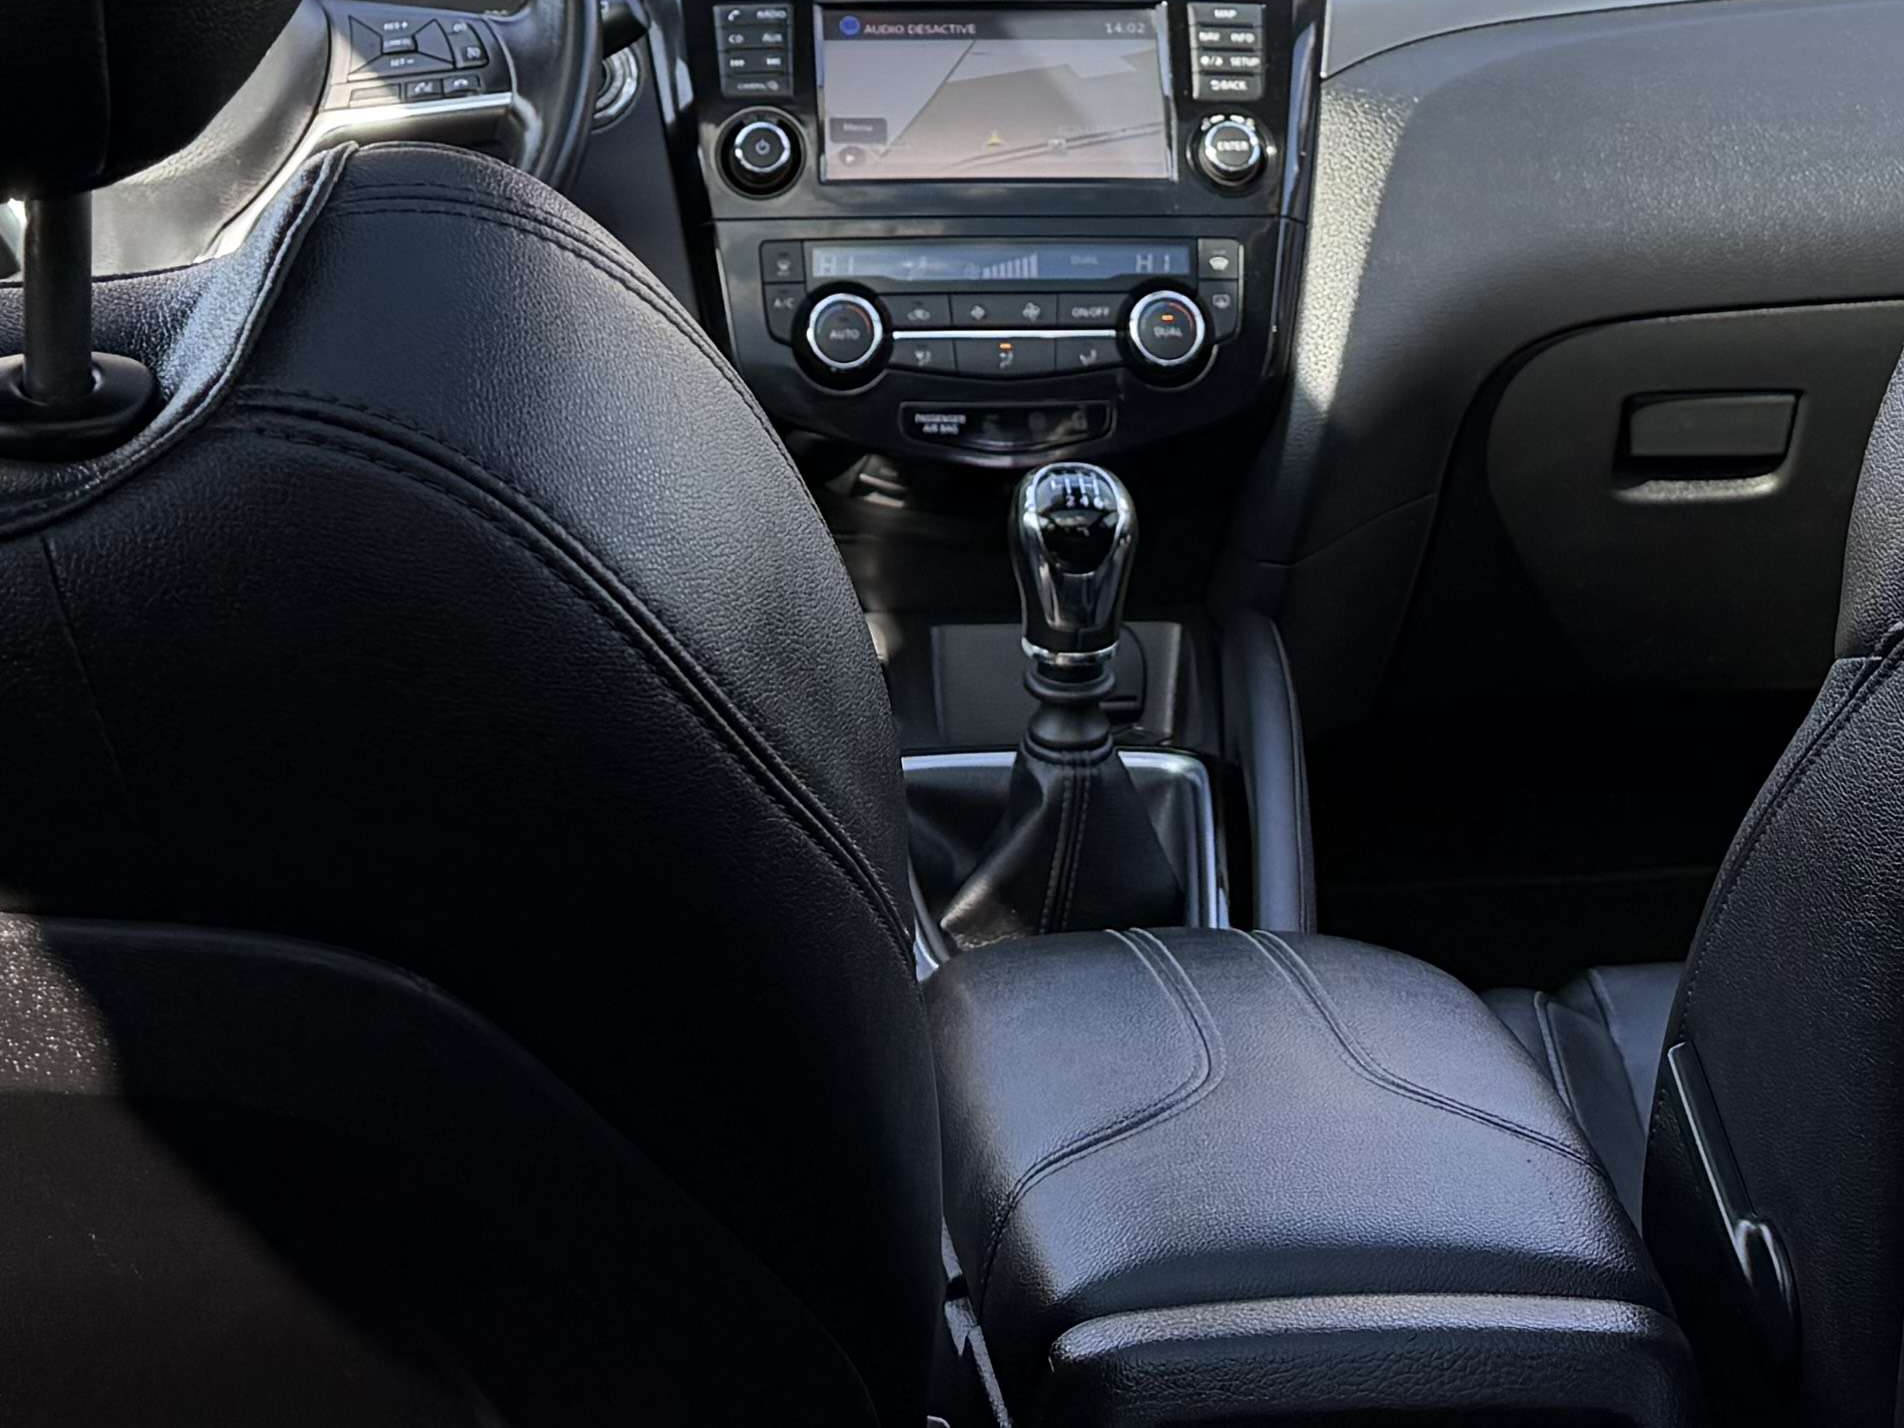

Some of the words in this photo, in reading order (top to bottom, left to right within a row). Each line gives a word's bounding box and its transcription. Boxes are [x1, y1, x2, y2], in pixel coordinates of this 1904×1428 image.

[864, 24, 904, 34] AUDIO
[1105, 22, 1144, 34] 14:02
[829, 329, 860, 340] AUTO
